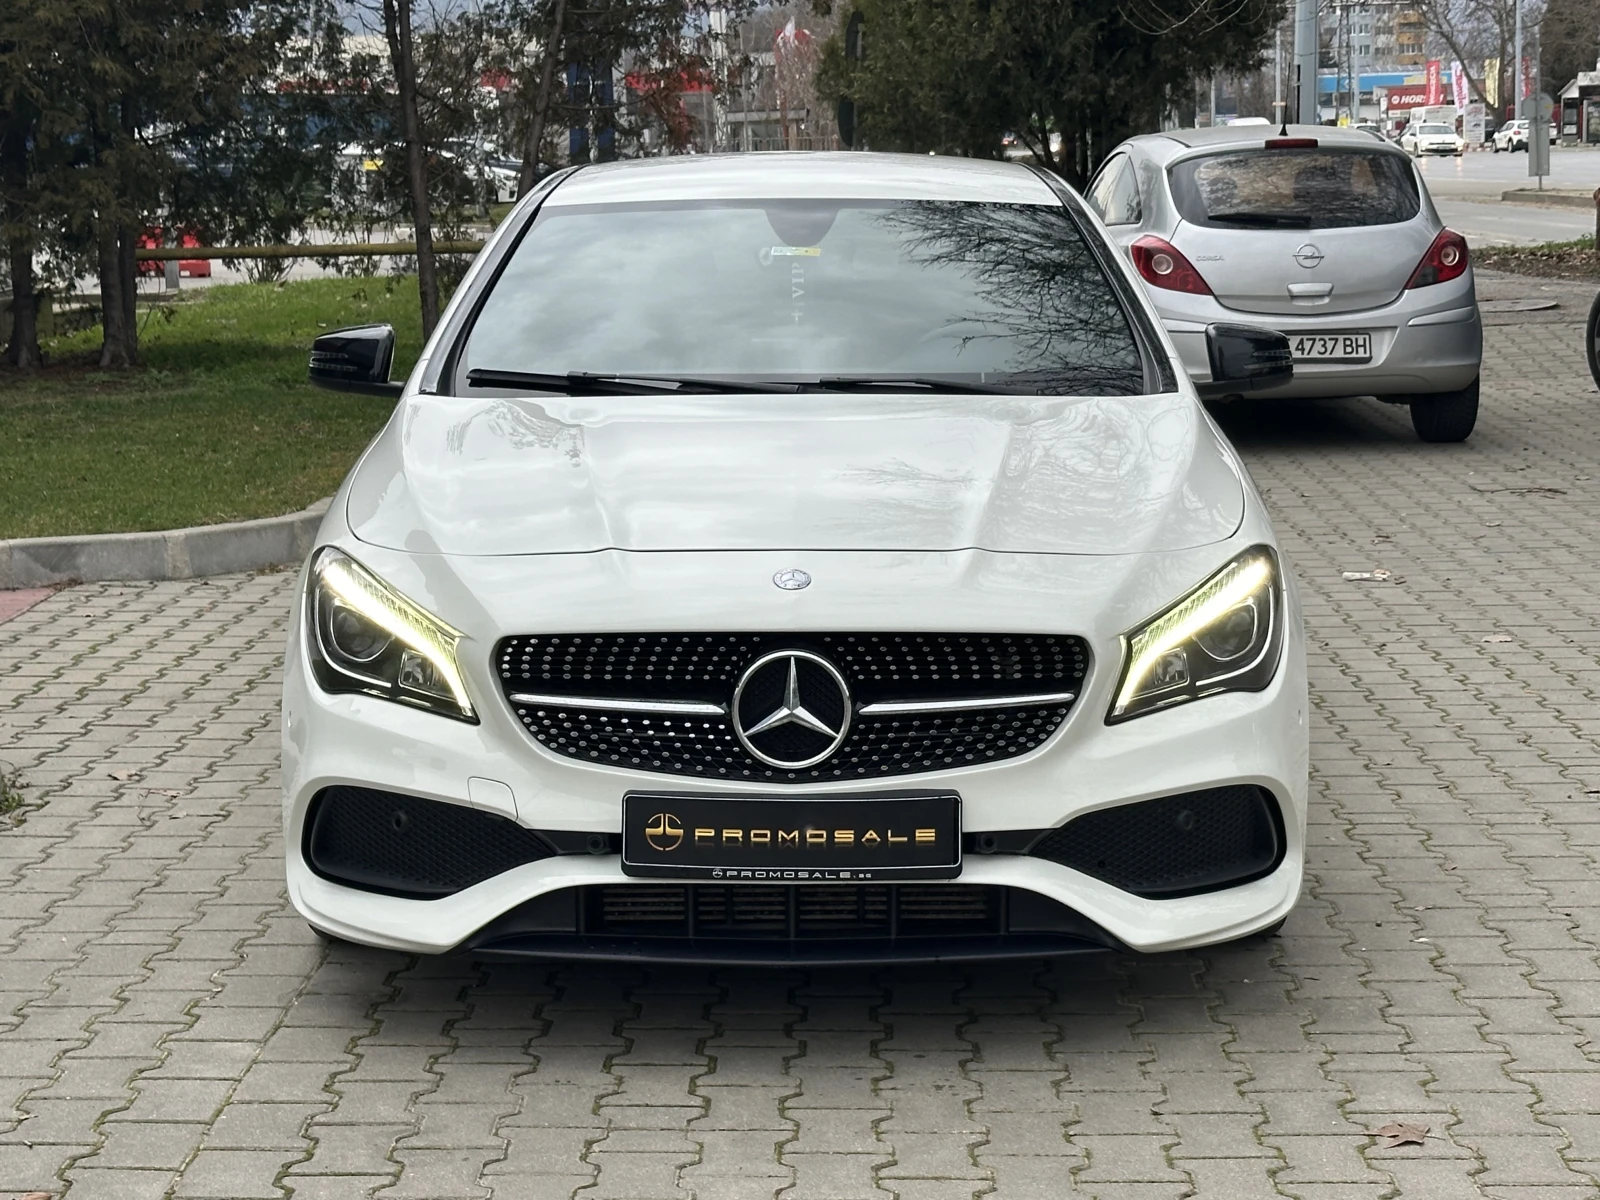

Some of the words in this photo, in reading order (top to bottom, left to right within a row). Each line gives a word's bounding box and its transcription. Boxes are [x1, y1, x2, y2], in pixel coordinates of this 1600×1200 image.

[1294, 337, 1339, 356] 4737
[1342, 337, 1367, 355] BH
[694, 827, 937, 843] PROMOSALE
